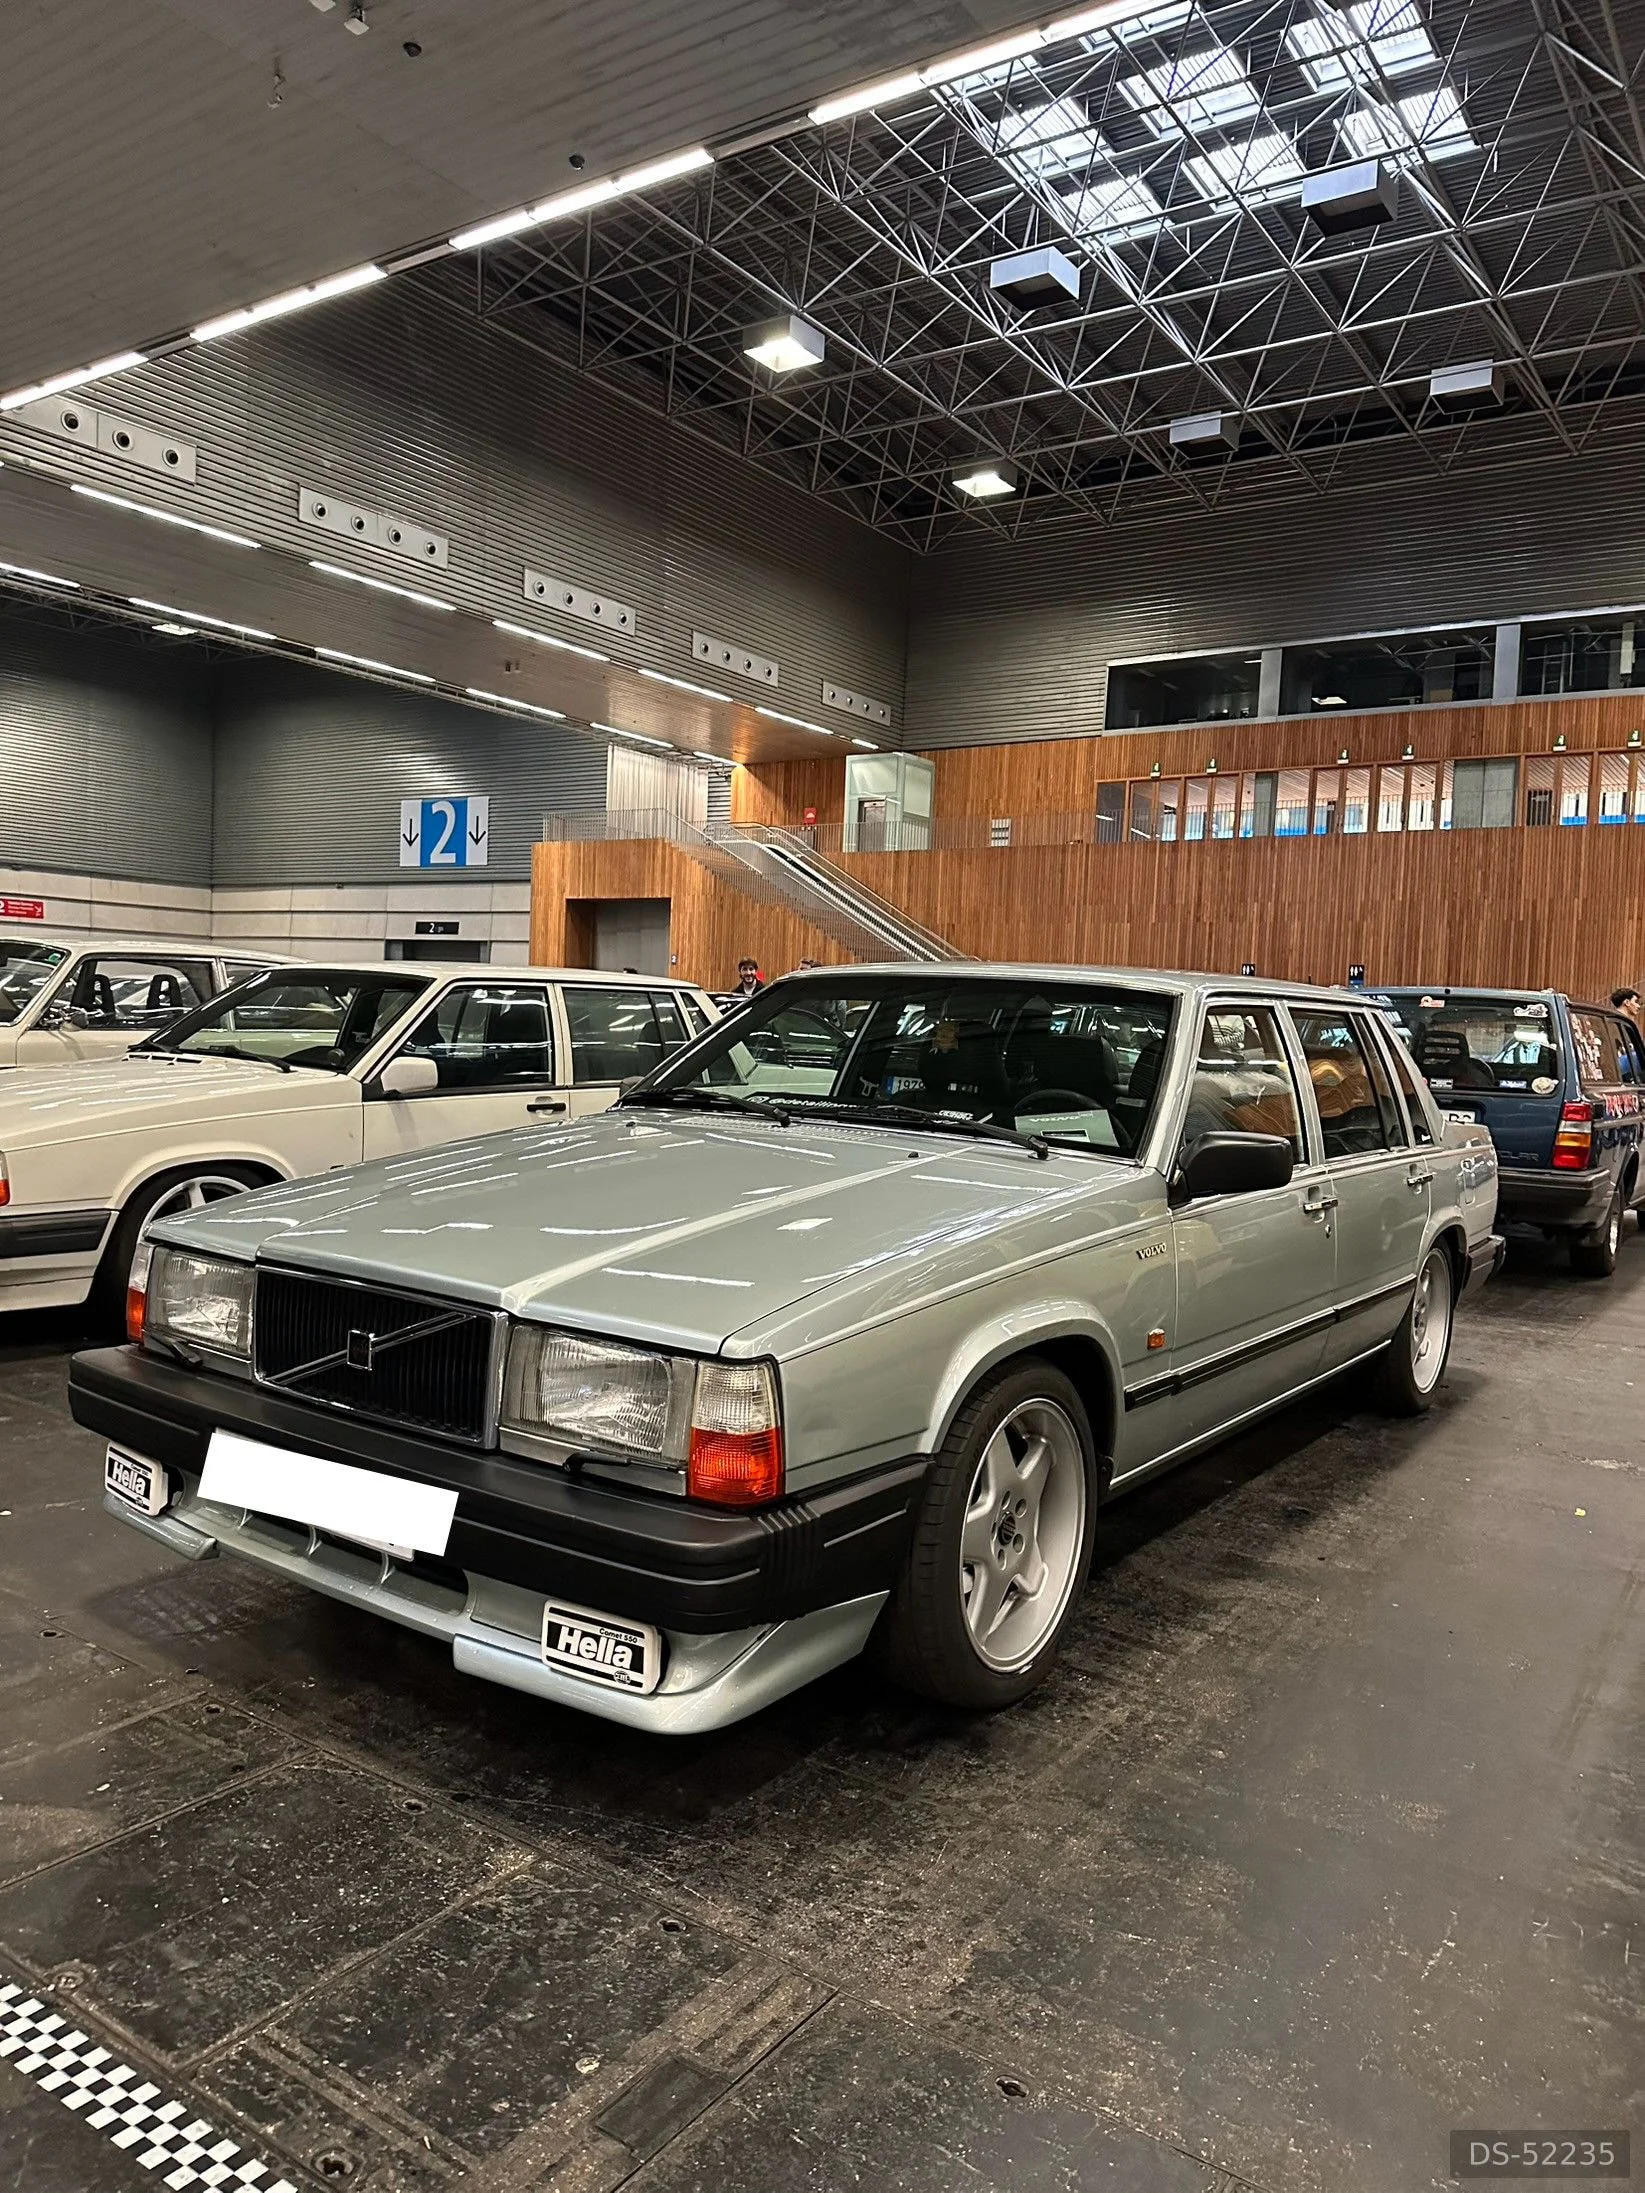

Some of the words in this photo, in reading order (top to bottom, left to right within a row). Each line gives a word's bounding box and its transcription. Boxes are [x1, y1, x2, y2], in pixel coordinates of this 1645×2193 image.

[430, 800, 456, 864] 2
[429, 922, 435, 933] 2
[1136, 1243, 1167, 1260] VOLVO
[112, 1460, 146, 1496] Hella
[557, 1625, 633, 1670] Hella
